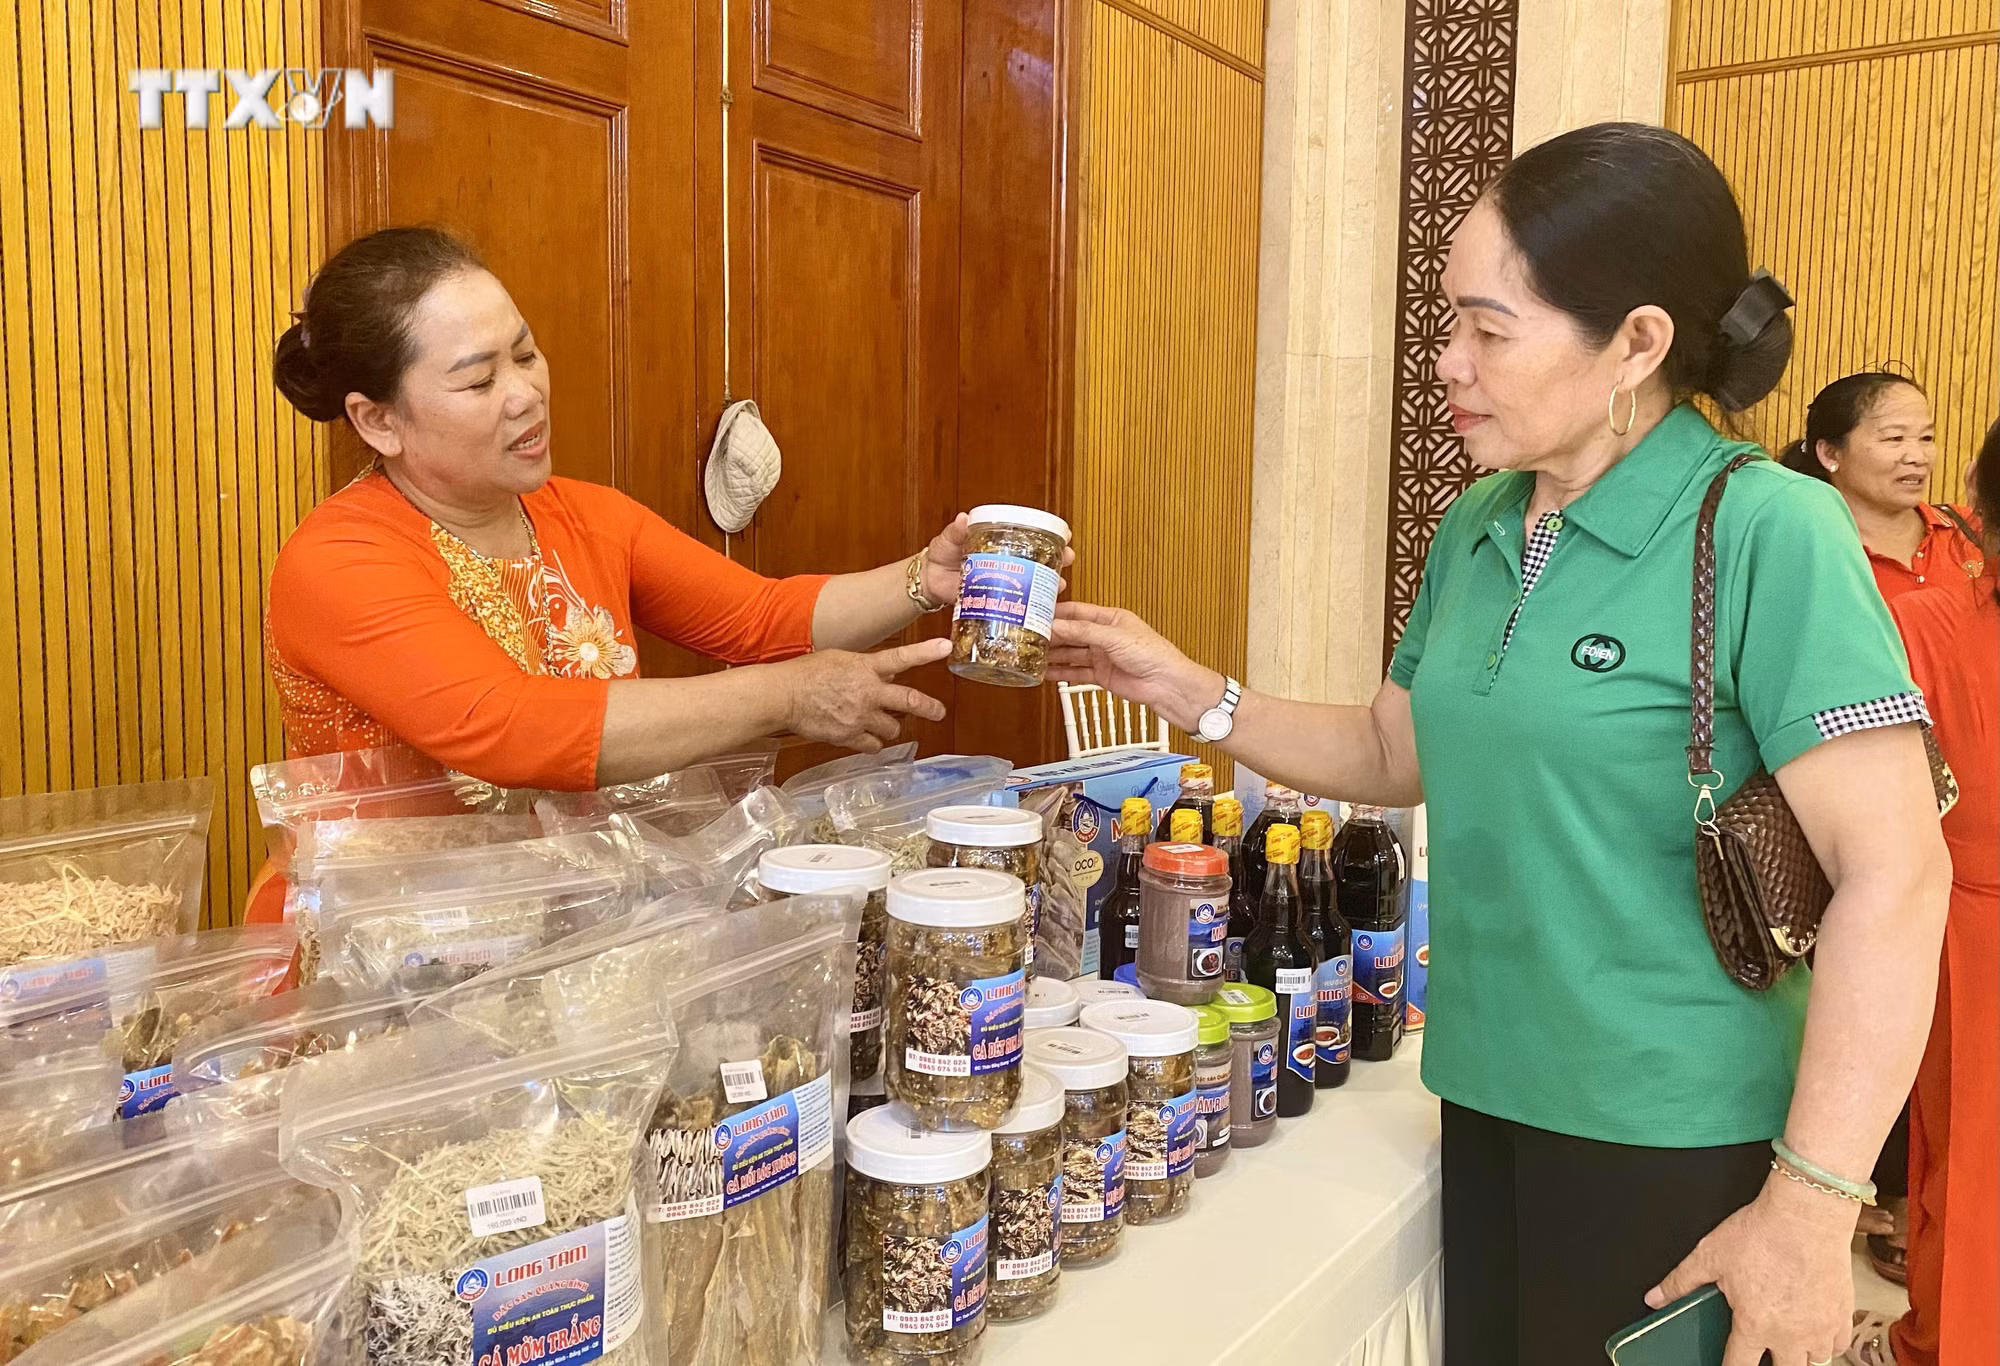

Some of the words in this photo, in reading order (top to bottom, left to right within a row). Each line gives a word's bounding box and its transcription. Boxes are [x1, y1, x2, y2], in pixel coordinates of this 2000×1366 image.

[1074, 856, 1100, 872] OCOP
[1196, 1096, 1213, 1114] ẮM
[734, 1114, 764, 1137] LONG
[726, 1174, 740, 1196] CÁ
[494, 1257, 544, 1289] LONG
[546, 1244, 589, 1271] TÂM
[487, 1323, 498, 1336] ĐỦ
[498, 1320, 515, 1332] ĐIỀU
[515, 1316, 531, 1327] KIỆN
[531, 1312, 542, 1321] AN
[541, 1306, 560, 1318] TOÀN
[559, 1301, 577, 1312] THỰC
[576, 1292, 595, 1306] PHẨM
[899, 1322, 918, 1330] 0945
[919, 1322, 934, 1330] 074
[936, 1320, 949, 1328] 542
[936, 1313, 949, 1321] 024
[478, 1344, 504, 1366] CÁ
[506, 1335, 546, 1366] MỜM
[547, 1313, 602, 1354] TRẮNG
